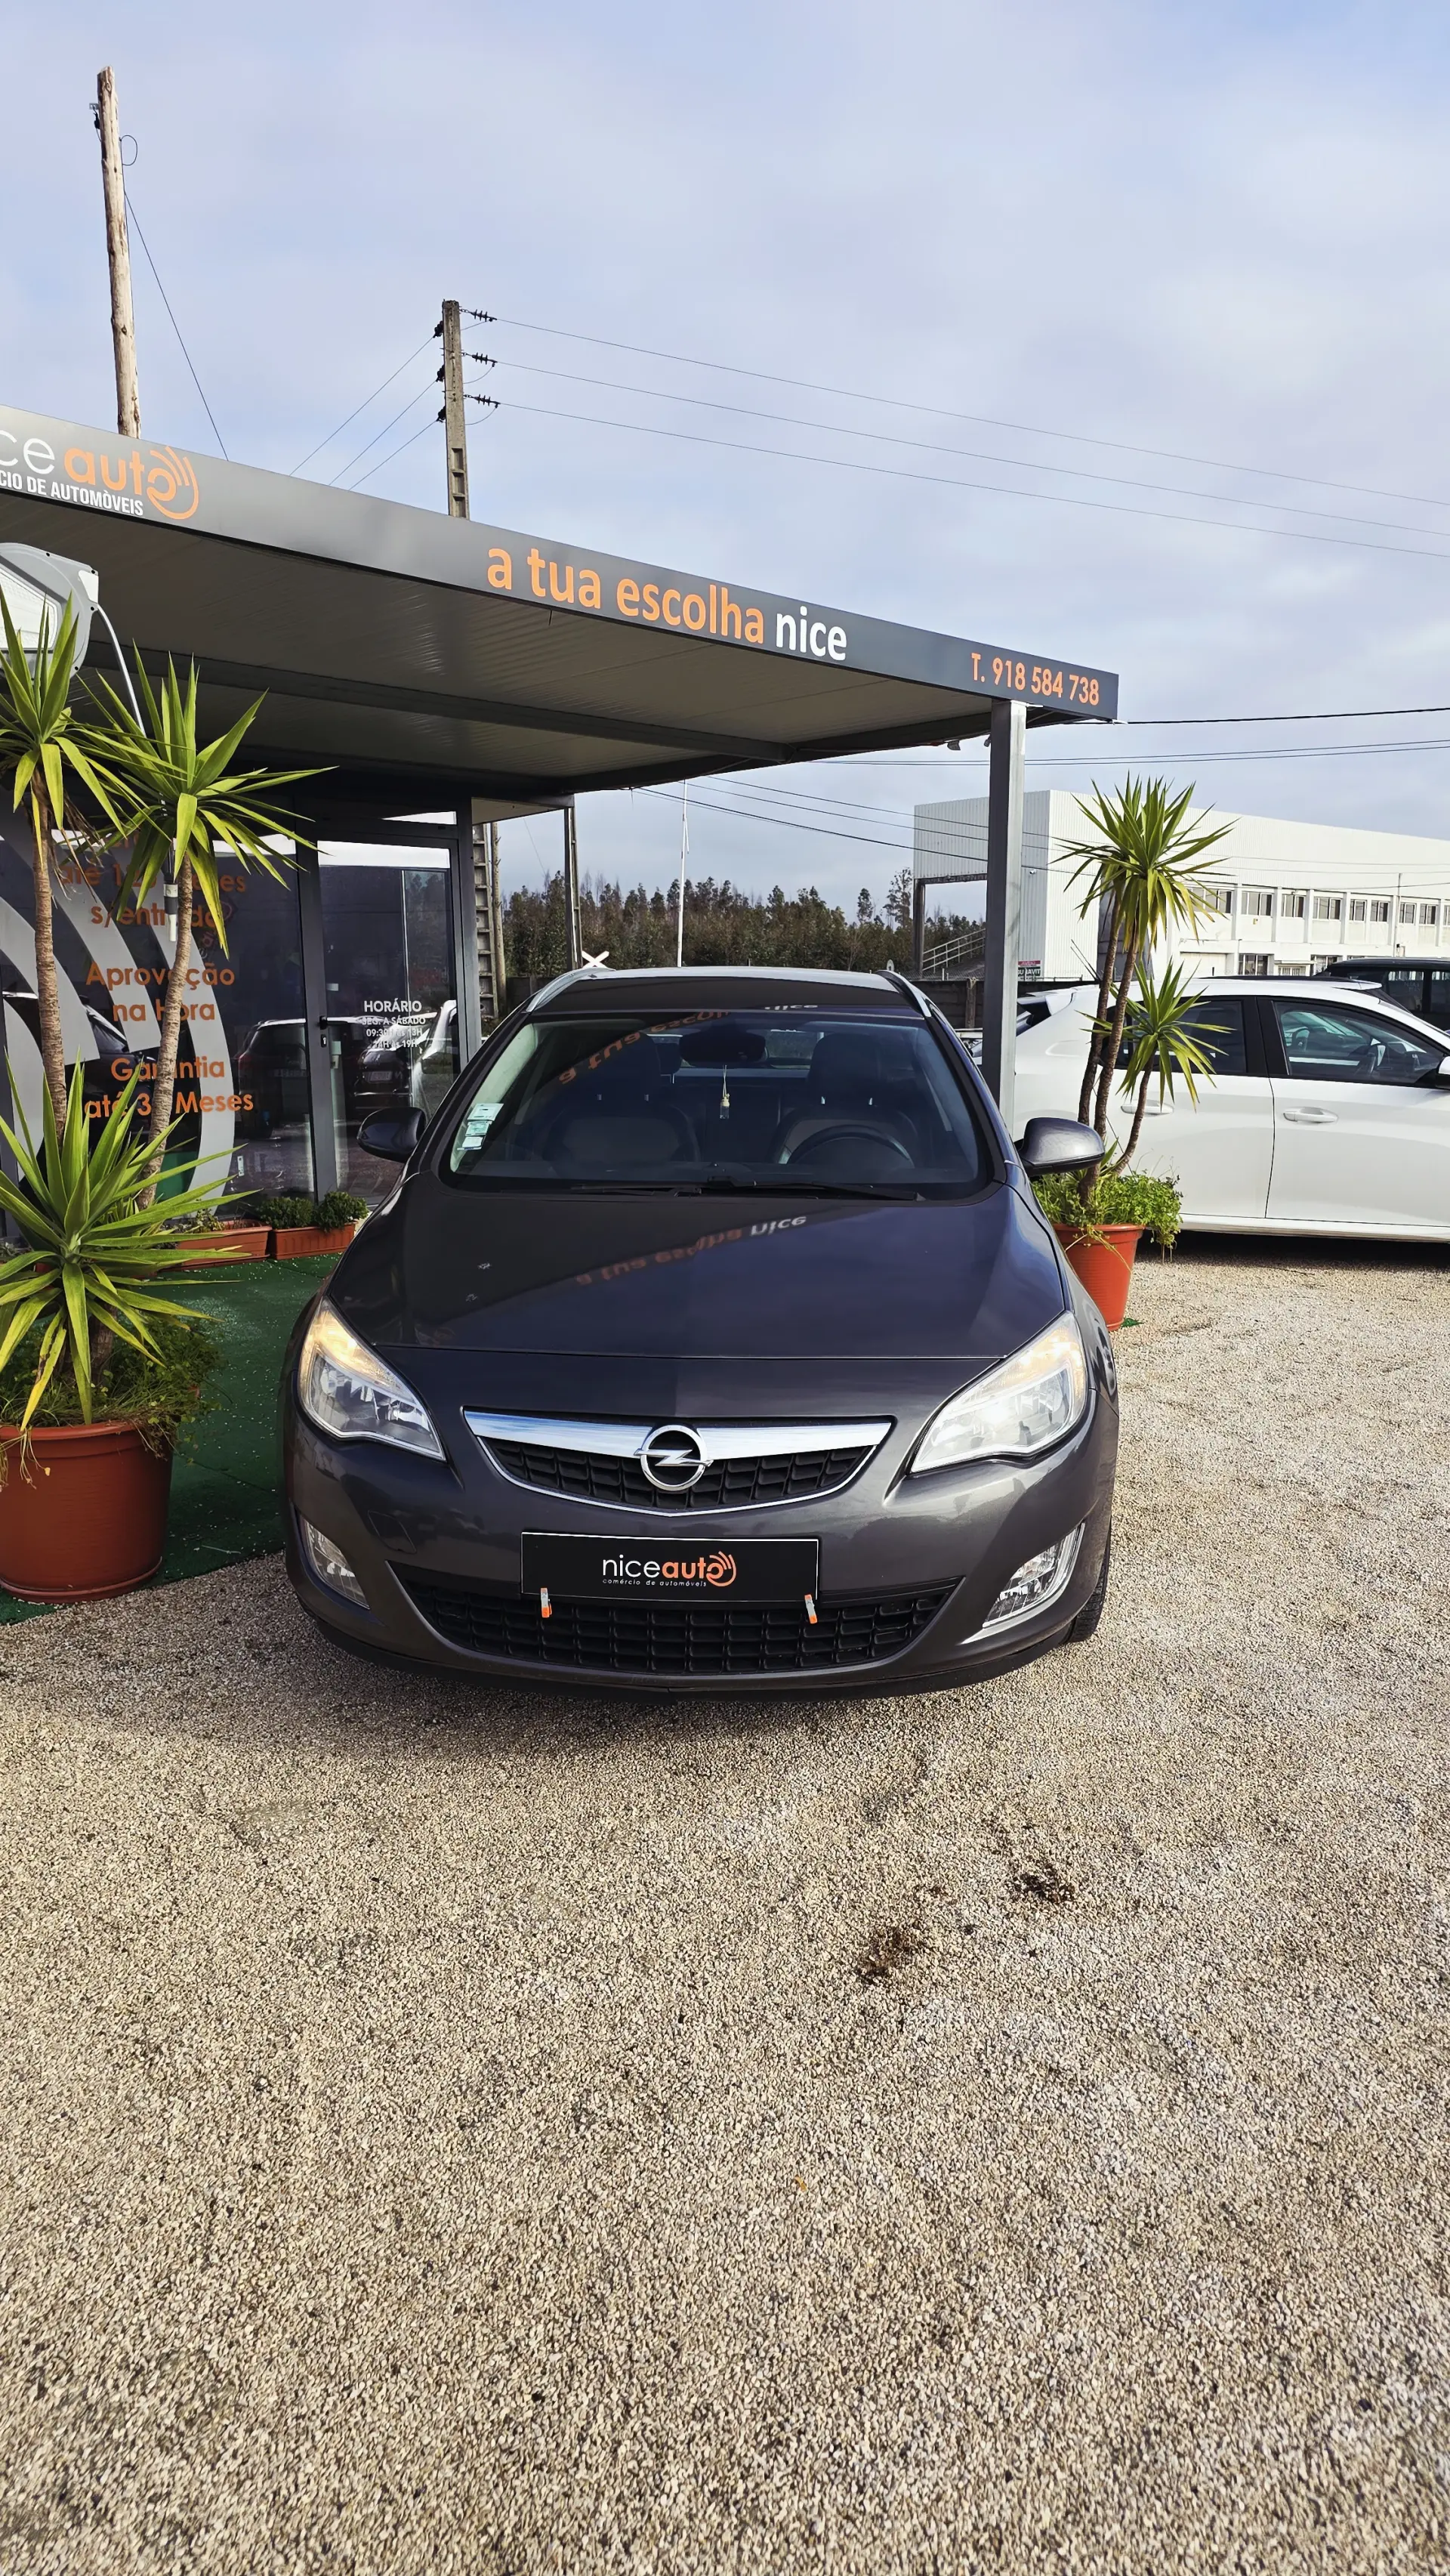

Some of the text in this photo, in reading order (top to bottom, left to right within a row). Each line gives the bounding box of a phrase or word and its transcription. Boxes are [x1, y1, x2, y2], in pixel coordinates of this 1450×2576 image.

[27, 476, 47, 496] DE
[487, 548, 847, 661] a tua escolha nice
[971, 653, 1100, 706] T. 918 584 738
[86, 961, 235, 991] Aprovção
[113, 1004, 146, 1021] na
[364, 998, 422, 1012] HORÁRIO
[391, 1015, 426, 1024] SÁBADO
[176, 1091, 254, 1114] Meses
